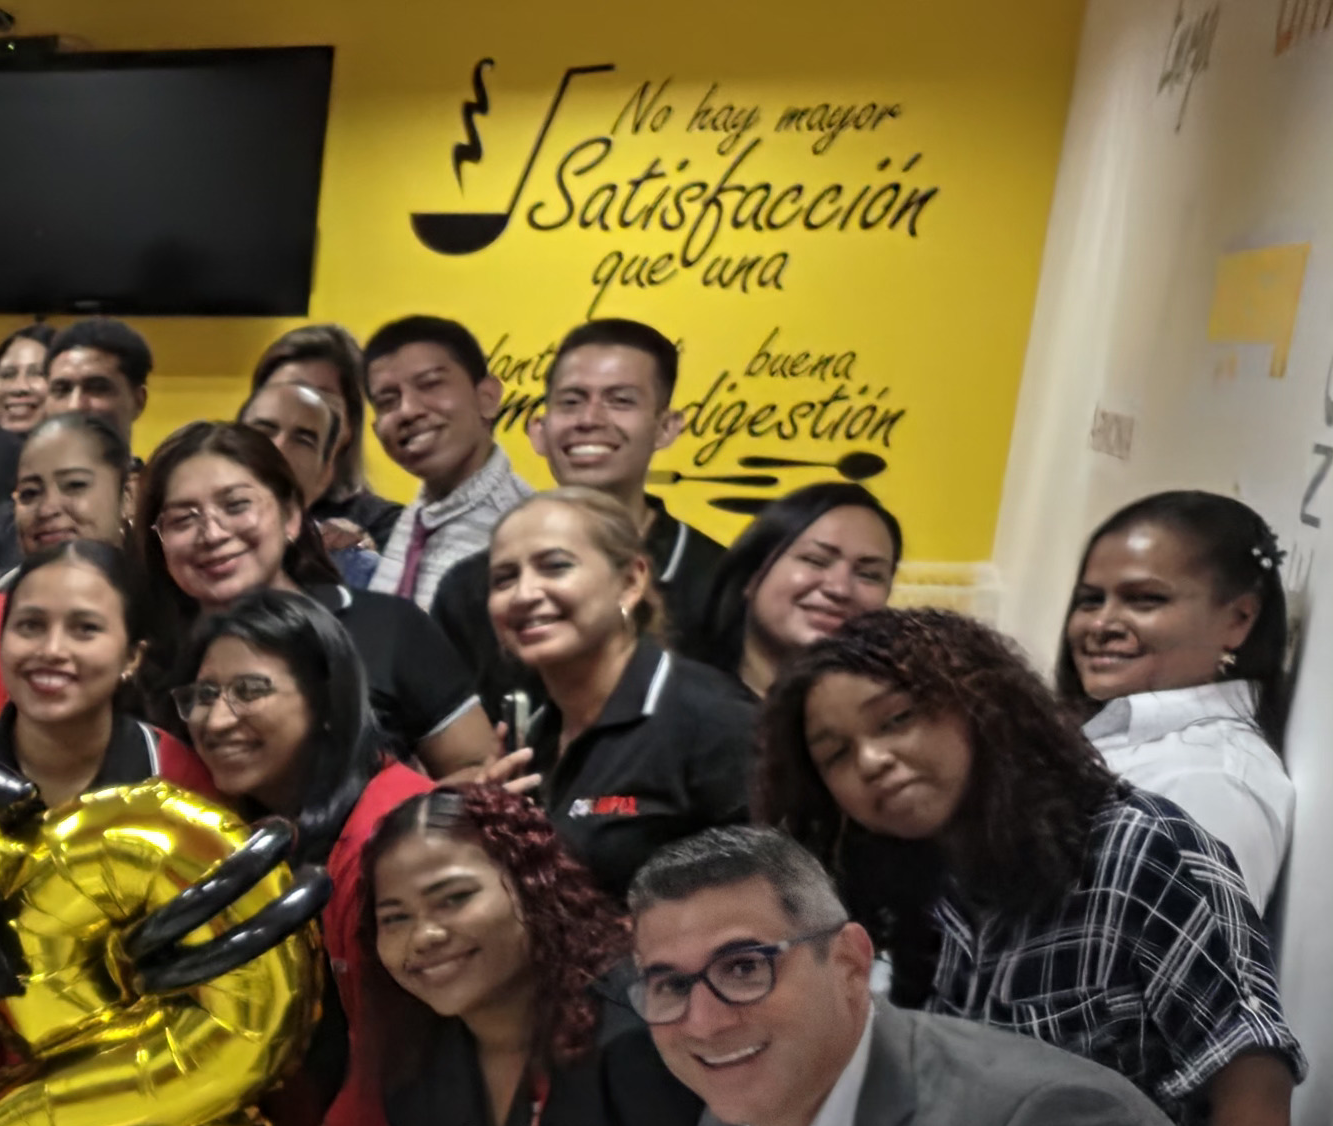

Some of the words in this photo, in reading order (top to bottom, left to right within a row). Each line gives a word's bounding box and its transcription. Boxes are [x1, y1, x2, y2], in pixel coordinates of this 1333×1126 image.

[611, 76, 673, 137] No
[686, 82, 760, 154] hay
[774, 102, 903, 154] mayor
[526, 136, 941, 268] Satisfacción
[587, 249, 678, 320] que
[701, 250, 790, 291] una
[743, 327, 858, 381] buena
[679, 370, 907, 467] digestión
